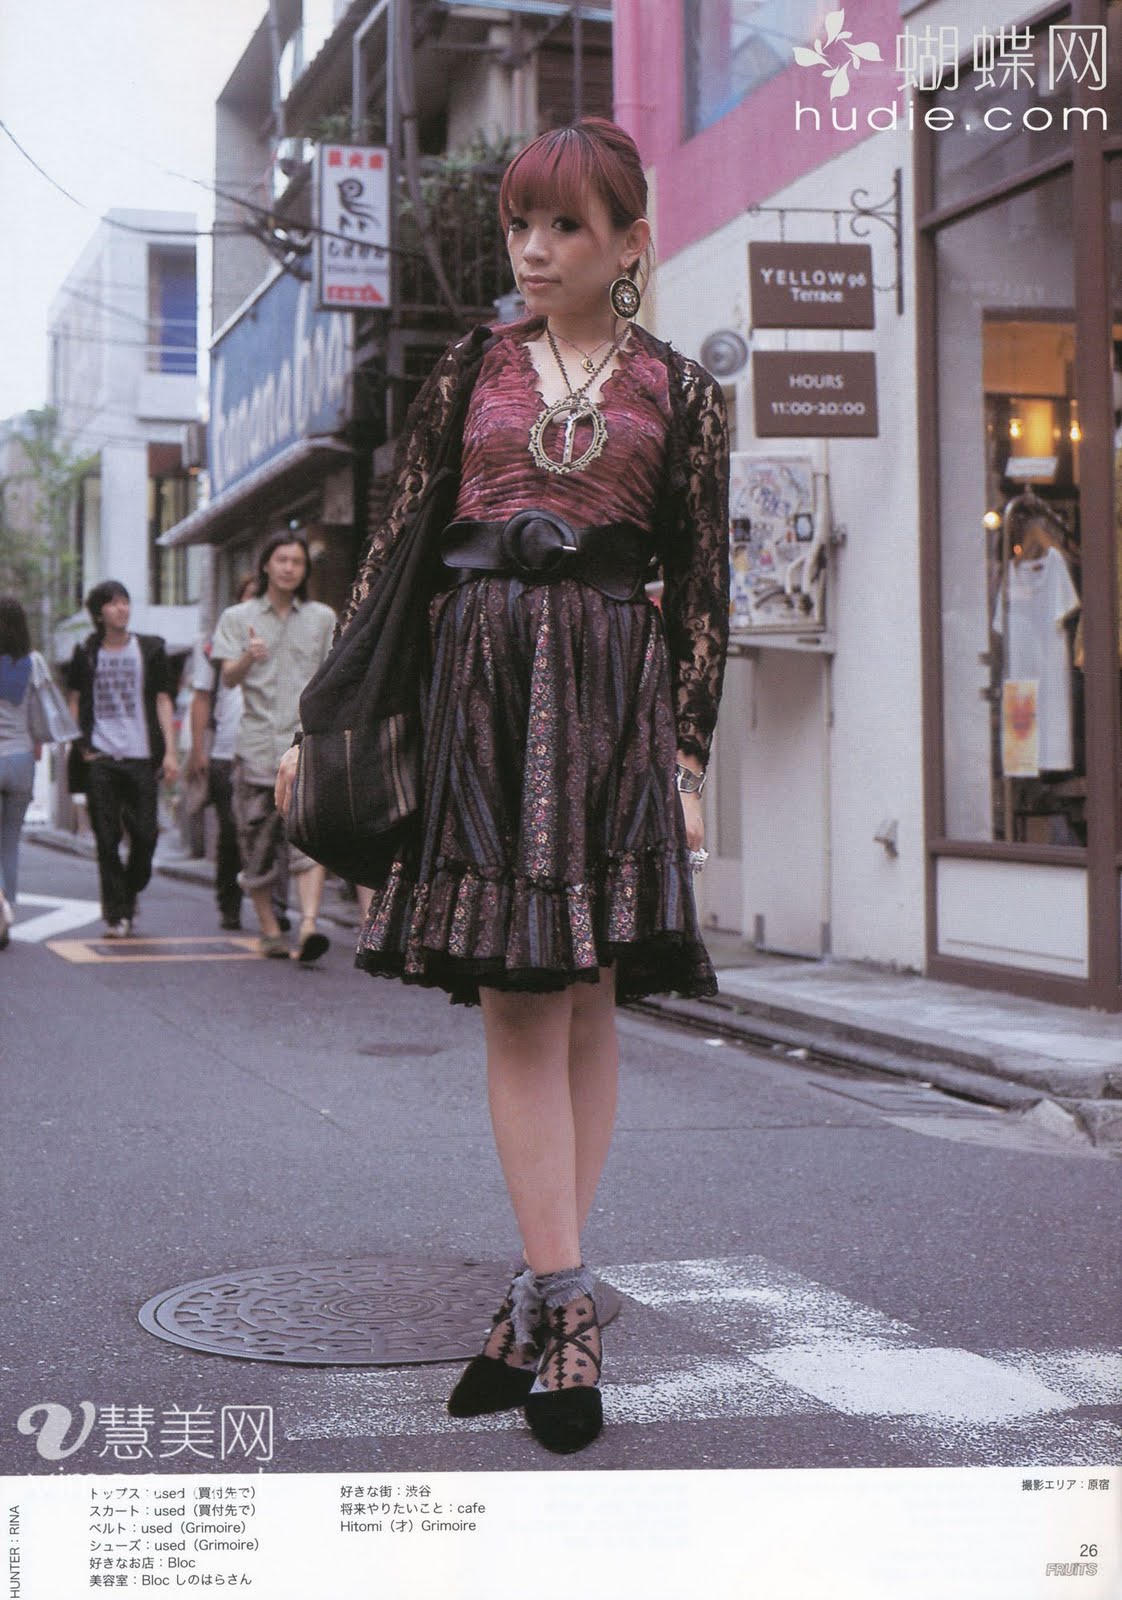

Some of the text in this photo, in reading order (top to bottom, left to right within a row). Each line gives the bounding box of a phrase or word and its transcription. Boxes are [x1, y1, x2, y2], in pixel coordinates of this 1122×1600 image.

[760, 268, 844, 286] YELLOW
[790, 287, 843, 303] Terrace
[789, 375, 844, 389] HOURS
[771, 402, 866, 416] 11:00-20:00
